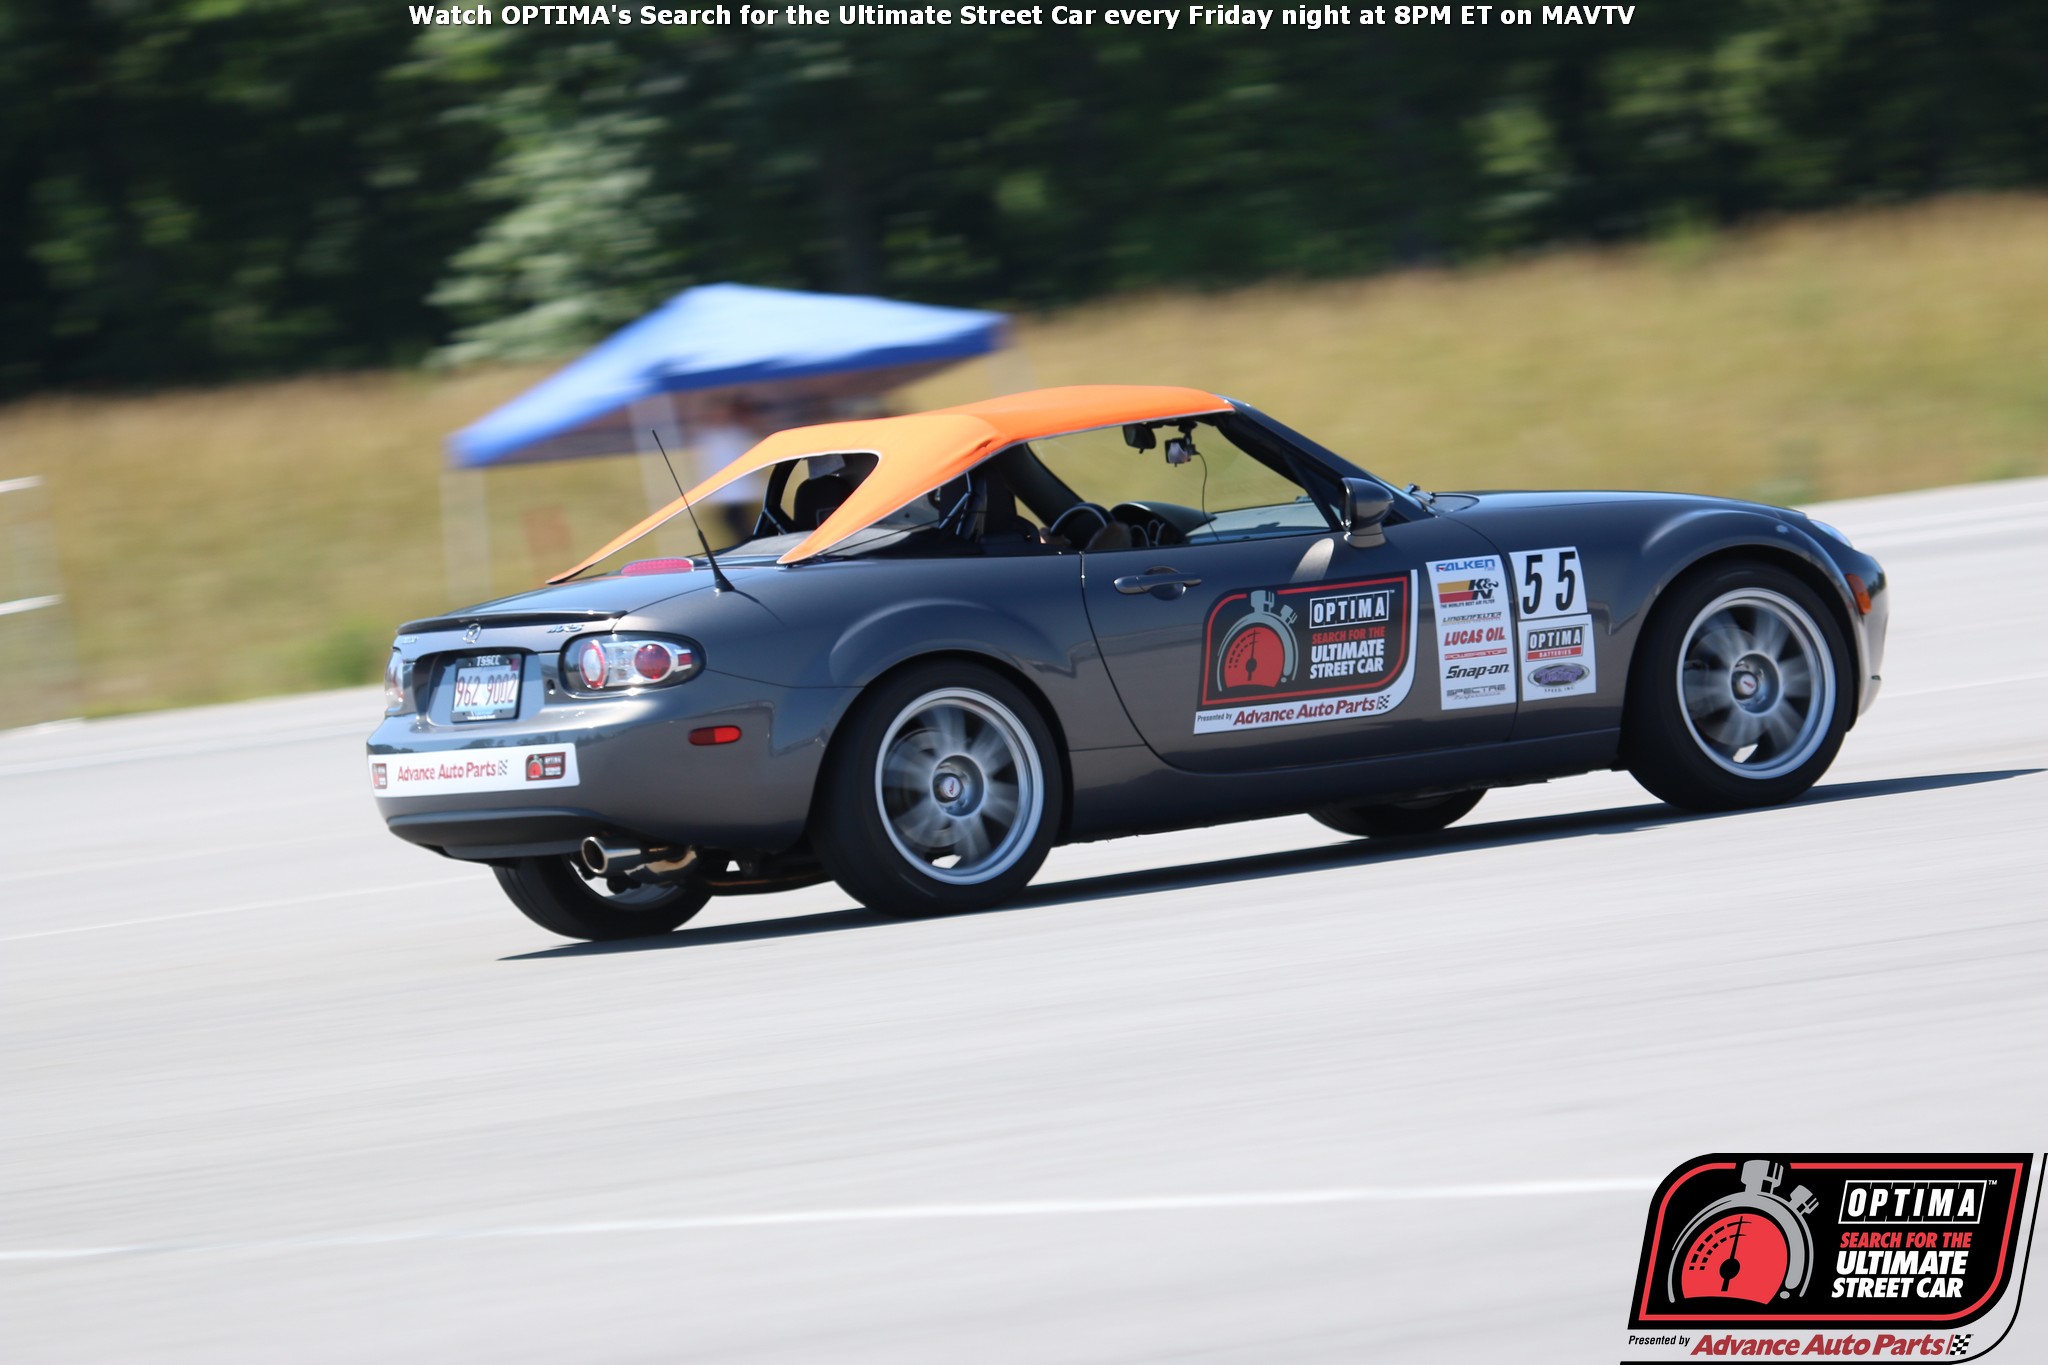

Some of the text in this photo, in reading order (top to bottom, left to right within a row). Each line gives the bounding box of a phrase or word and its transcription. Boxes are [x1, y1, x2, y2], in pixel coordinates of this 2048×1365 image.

[1435, 559, 1496, 573] FALKEN
[1313, 596, 1386, 624] OPTIMA
[1312, 626, 1386, 645] SEARCH FOR THE
[1444, 626, 1505, 646] LUCAS OIL
[1529, 628, 1581, 650] OPTIMA
[1311, 638, 1386, 663] ULTIMATE
[1309, 657, 1384, 680] STREET CAR
[1445, 663, 1510, 679] Snap-on
[455, 672, 517, 708] 962 9002
[1197, 713, 1232, 722] Presented by
[1233, 698, 1376, 726] Advance Auto Parts
[398, 766, 436, 782] Advance
[438, 763, 465, 780] Auto
[465, 760, 497, 778] Parts
